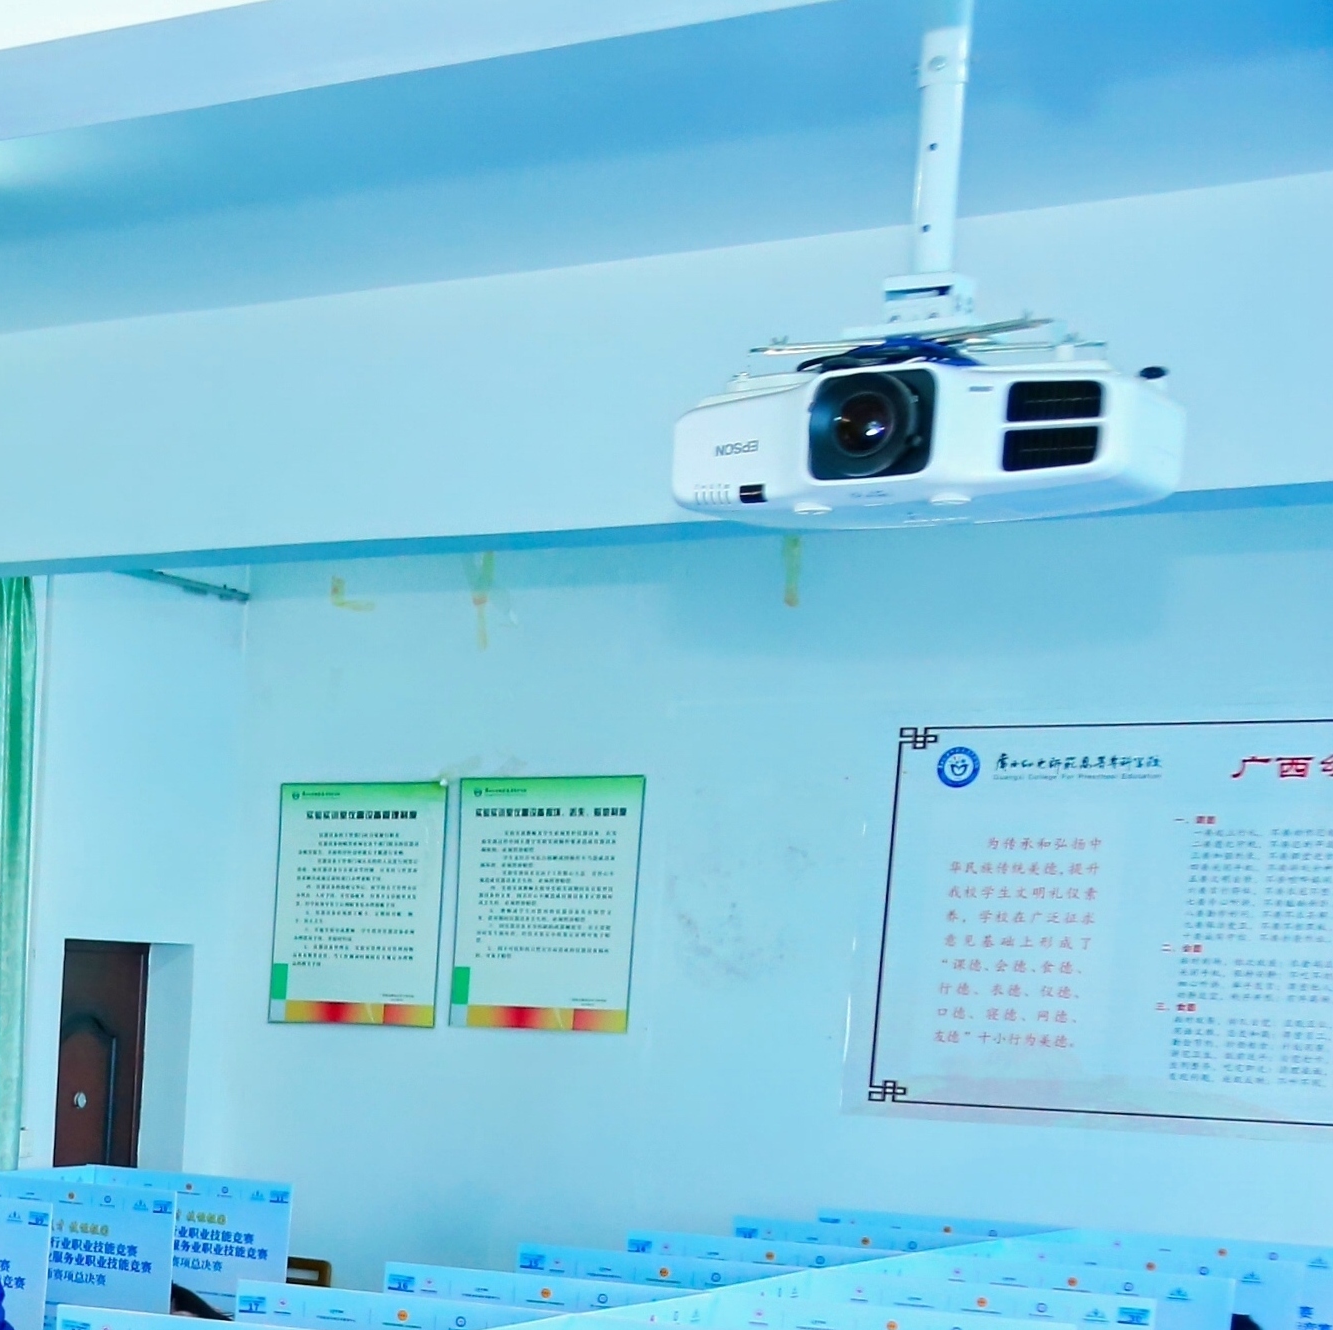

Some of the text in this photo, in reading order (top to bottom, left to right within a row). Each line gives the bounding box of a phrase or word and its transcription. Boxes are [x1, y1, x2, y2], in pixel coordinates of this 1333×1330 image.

[715, 440, 759, 456] EPSON
[988, 837, 1102, 850] 为传承和弘扬中
